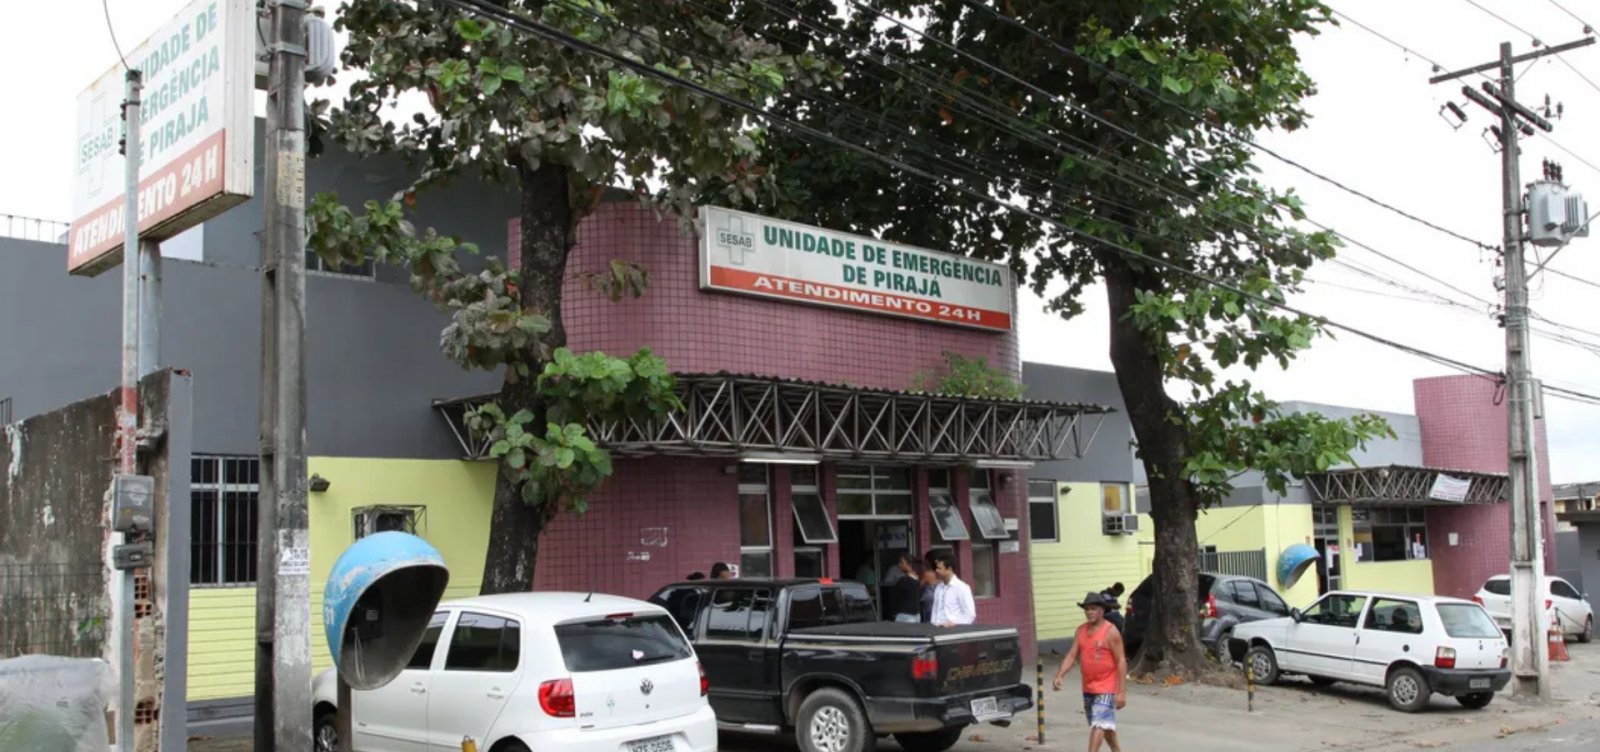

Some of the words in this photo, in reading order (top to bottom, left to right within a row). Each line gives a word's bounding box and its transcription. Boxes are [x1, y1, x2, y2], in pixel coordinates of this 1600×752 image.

[138, 22, 190, 83] IDADE
[196, 1, 217, 43] DE
[121, 44, 220, 139] ERGÊNCIA
[82, 127, 113, 163] SESAB
[150, 87, 209, 159] PIRAJÁ
[73, 172, 178, 258] ATENDIENTO
[719, 232, 753, 248] SESAB
[763, 225, 856, 260] UNIDADE
[862, 244, 887, 266] DE
[892, 250, 1003, 287] EMERGÊNCIA
[843, 264, 867, 285] DE
[873, 269, 942, 298] PIRAJÁ
[753, 275, 932, 314] ATENDIMENTO
